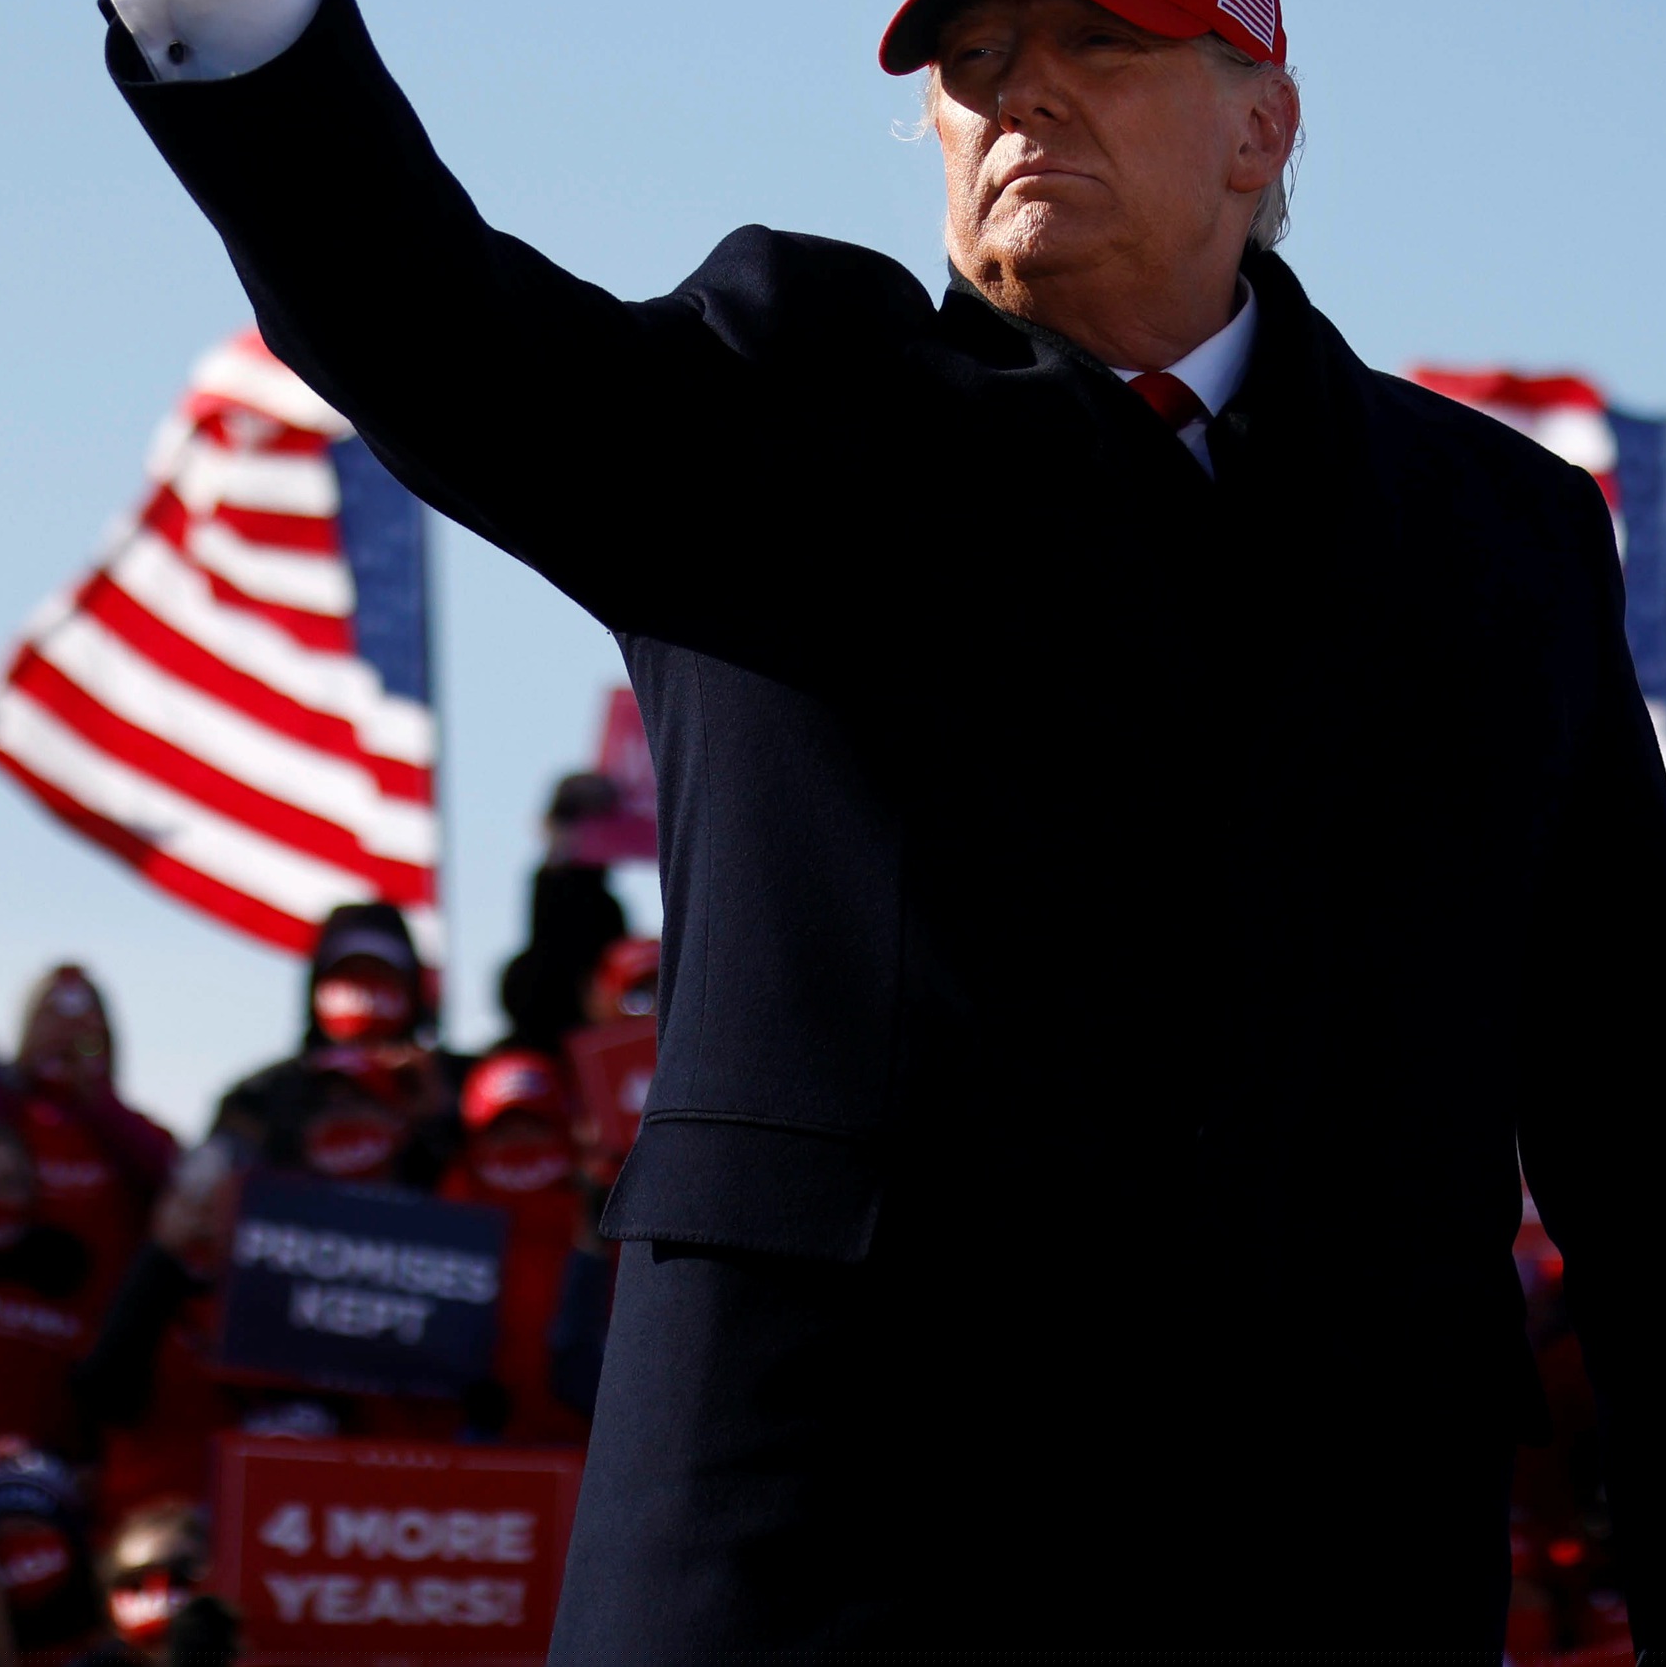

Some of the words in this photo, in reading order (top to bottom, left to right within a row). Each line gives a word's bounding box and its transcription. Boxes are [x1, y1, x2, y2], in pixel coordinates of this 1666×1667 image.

[234, 1219, 498, 1304] PROMISES
[288, 1281, 433, 1346] KEPT
[259, 1502, 314, 1558] 4
[322, 1504, 537, 1563] MORE
[261, 1572, 528, 1626] YEARS!
